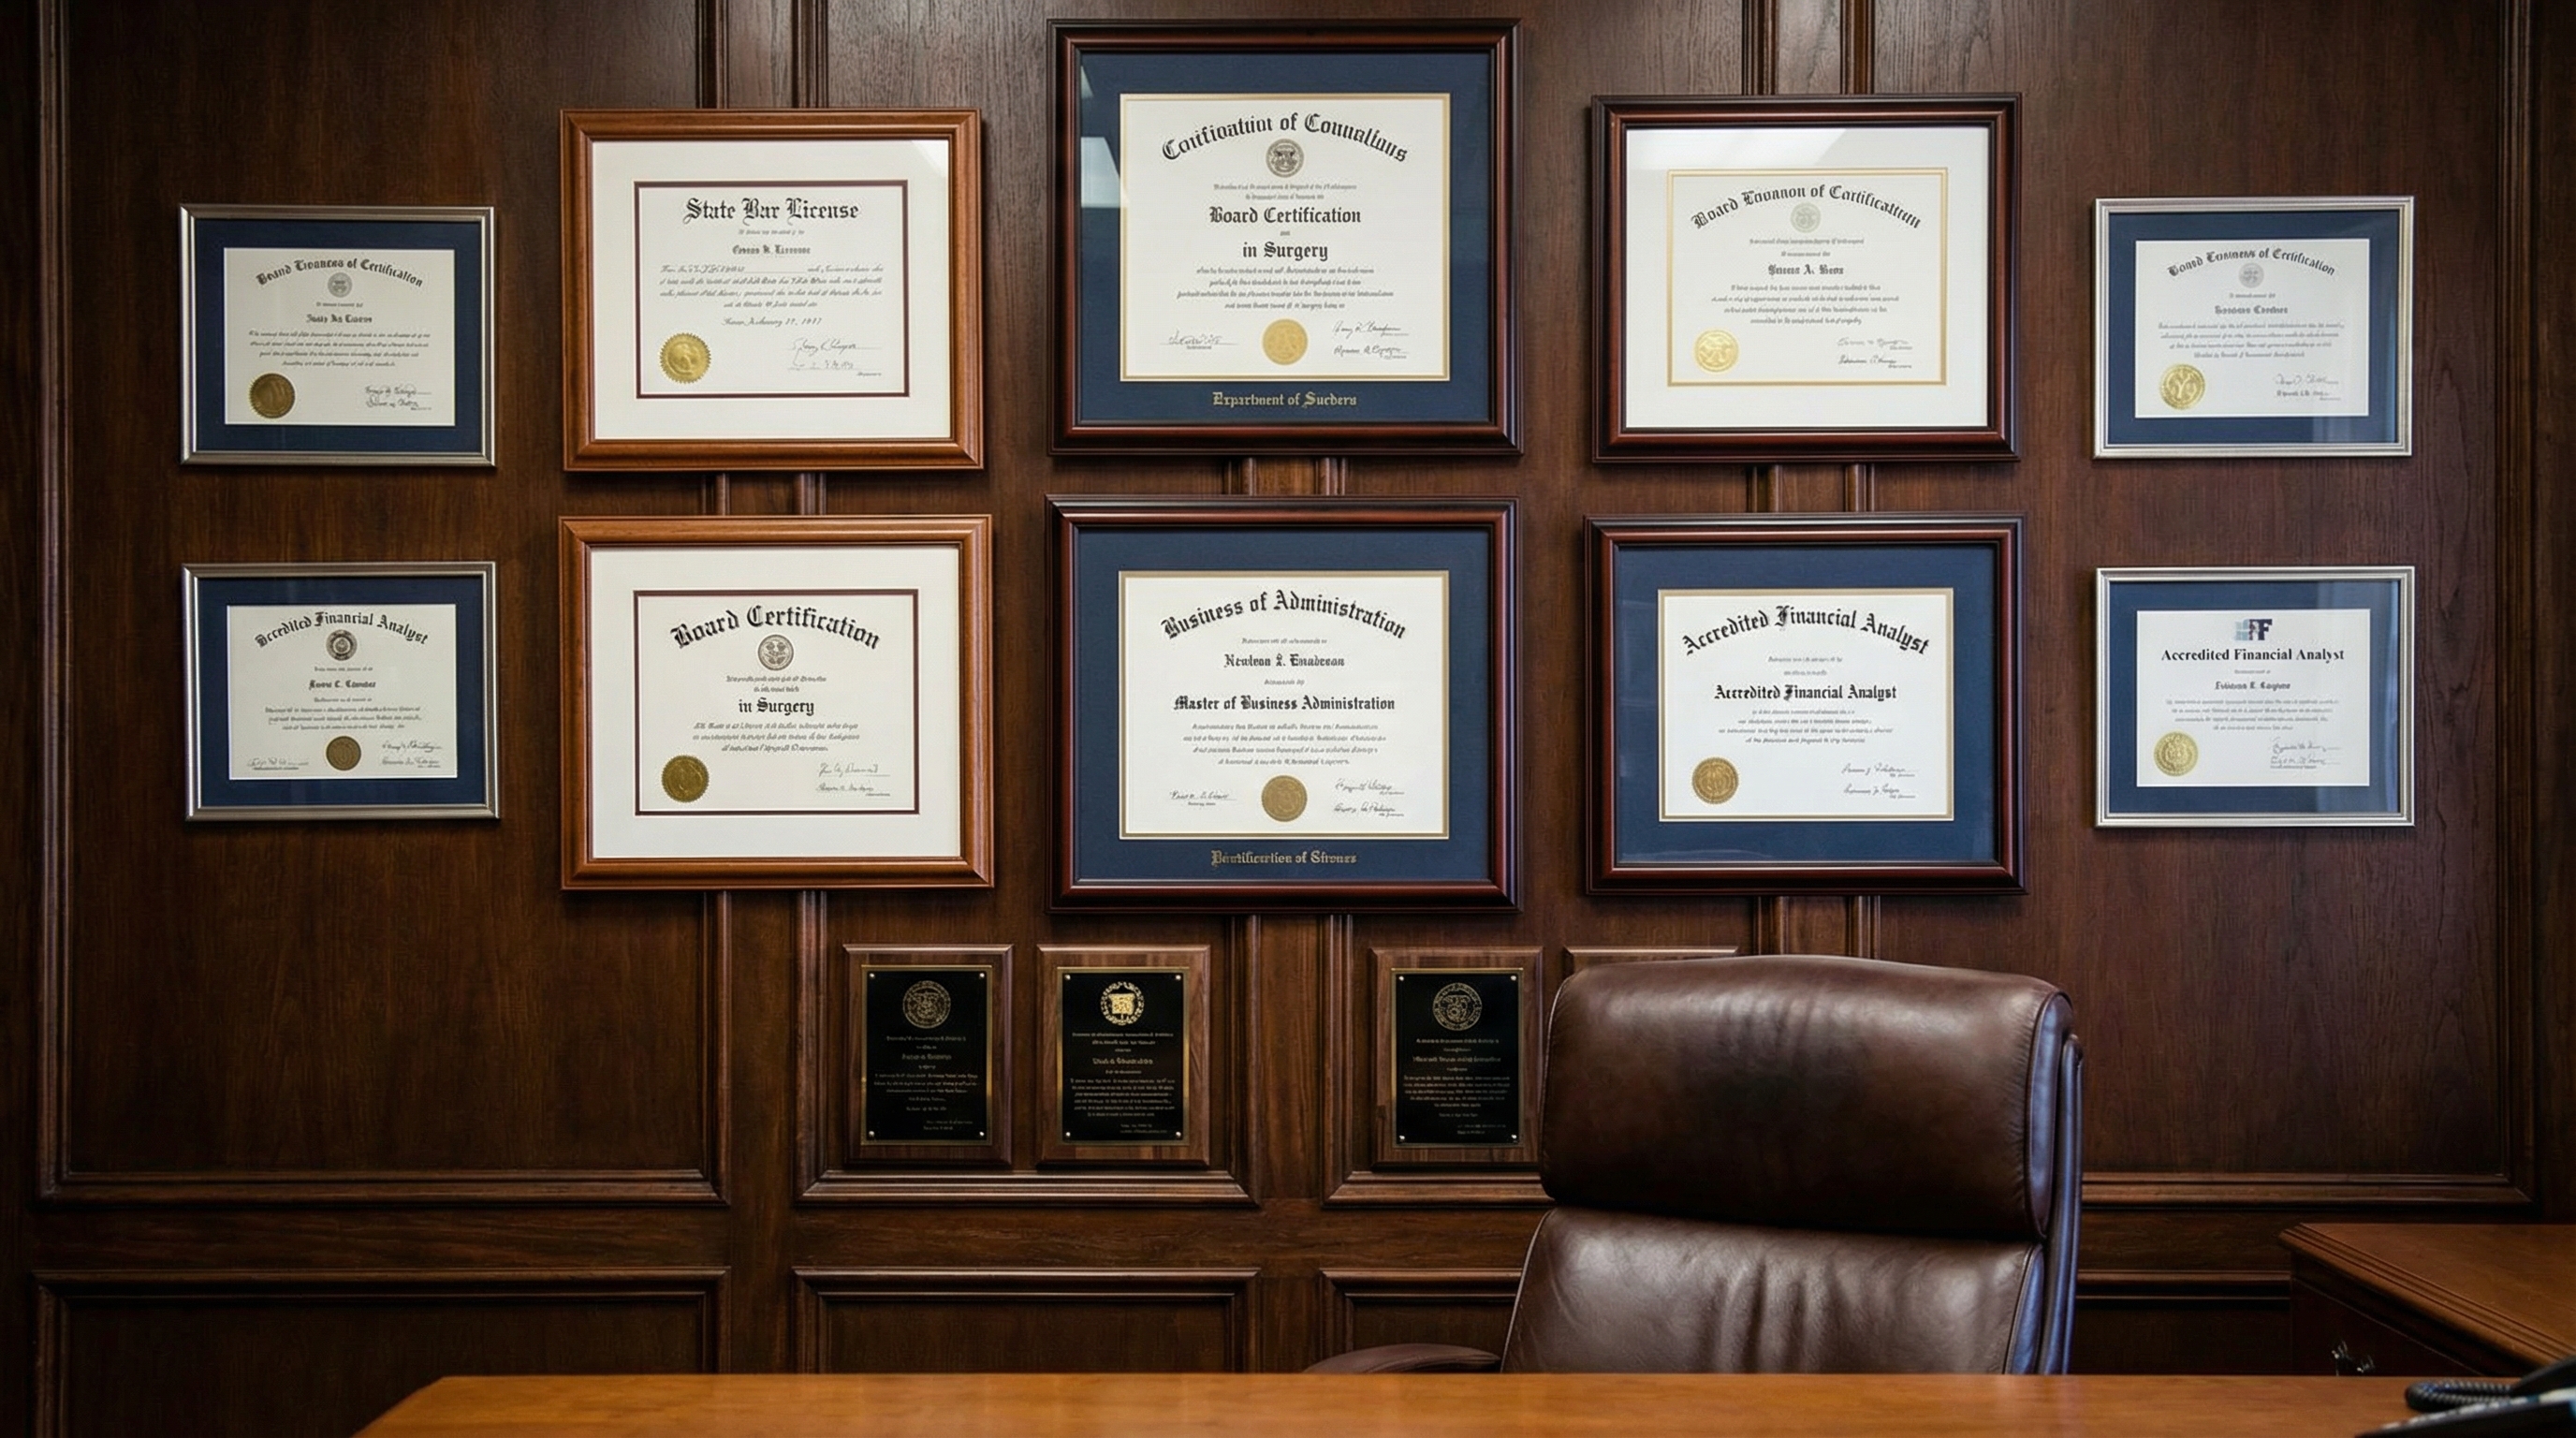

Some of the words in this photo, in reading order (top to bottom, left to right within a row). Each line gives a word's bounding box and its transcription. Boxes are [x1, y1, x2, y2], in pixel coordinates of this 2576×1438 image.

[1280, 112, 1298, 131] of
[1810, 184, 1825, 198] of
[683, 198, 736, 225] State
[742, 198, 781, 226] Bar
[786, 198, 859, 226] License
[1209, 206, 1258, 224] Board
[1264, 206, 1362, 224] Certification
[1242, 242, 1257, 258] in
[1263, 241, 1329, 262] Surgery
[1287, 392, 1301, 405] of
[1160, 598, 1244, 639] Business
[1250, 591, 1268, 612] of
[1273, 589, 1407, 639] Administration
[376, 614, 429, 645] Analyst
[670, 609, 739, 649] Board
[747, 605, 881, 650] Certification
[1682, 609, 1770, 655] Accredited
[1775, 605, 1858, 630] Financial
[1860, 612, 1930, 655] Analyst
[2160, 649, 2230, 661] Accredited
[2233, 649, 2292, 661] Financial
[2296, 649, 2345, 664] Analyst
[1714, 684, 1780, 700] Accredited
[1783, 684, 1844, 701] Financial
[1847, 684, 1897, 702] Analyst
[739, 698, 753, 713] in
[756, 697, 815, 716] Surgery
[1173, 695, 1220, 712] Master
[1223, 695, 1237, 711] of
[1240, 695, 1298, 711] Business
[1301, 695, 1396, 711] Administration
